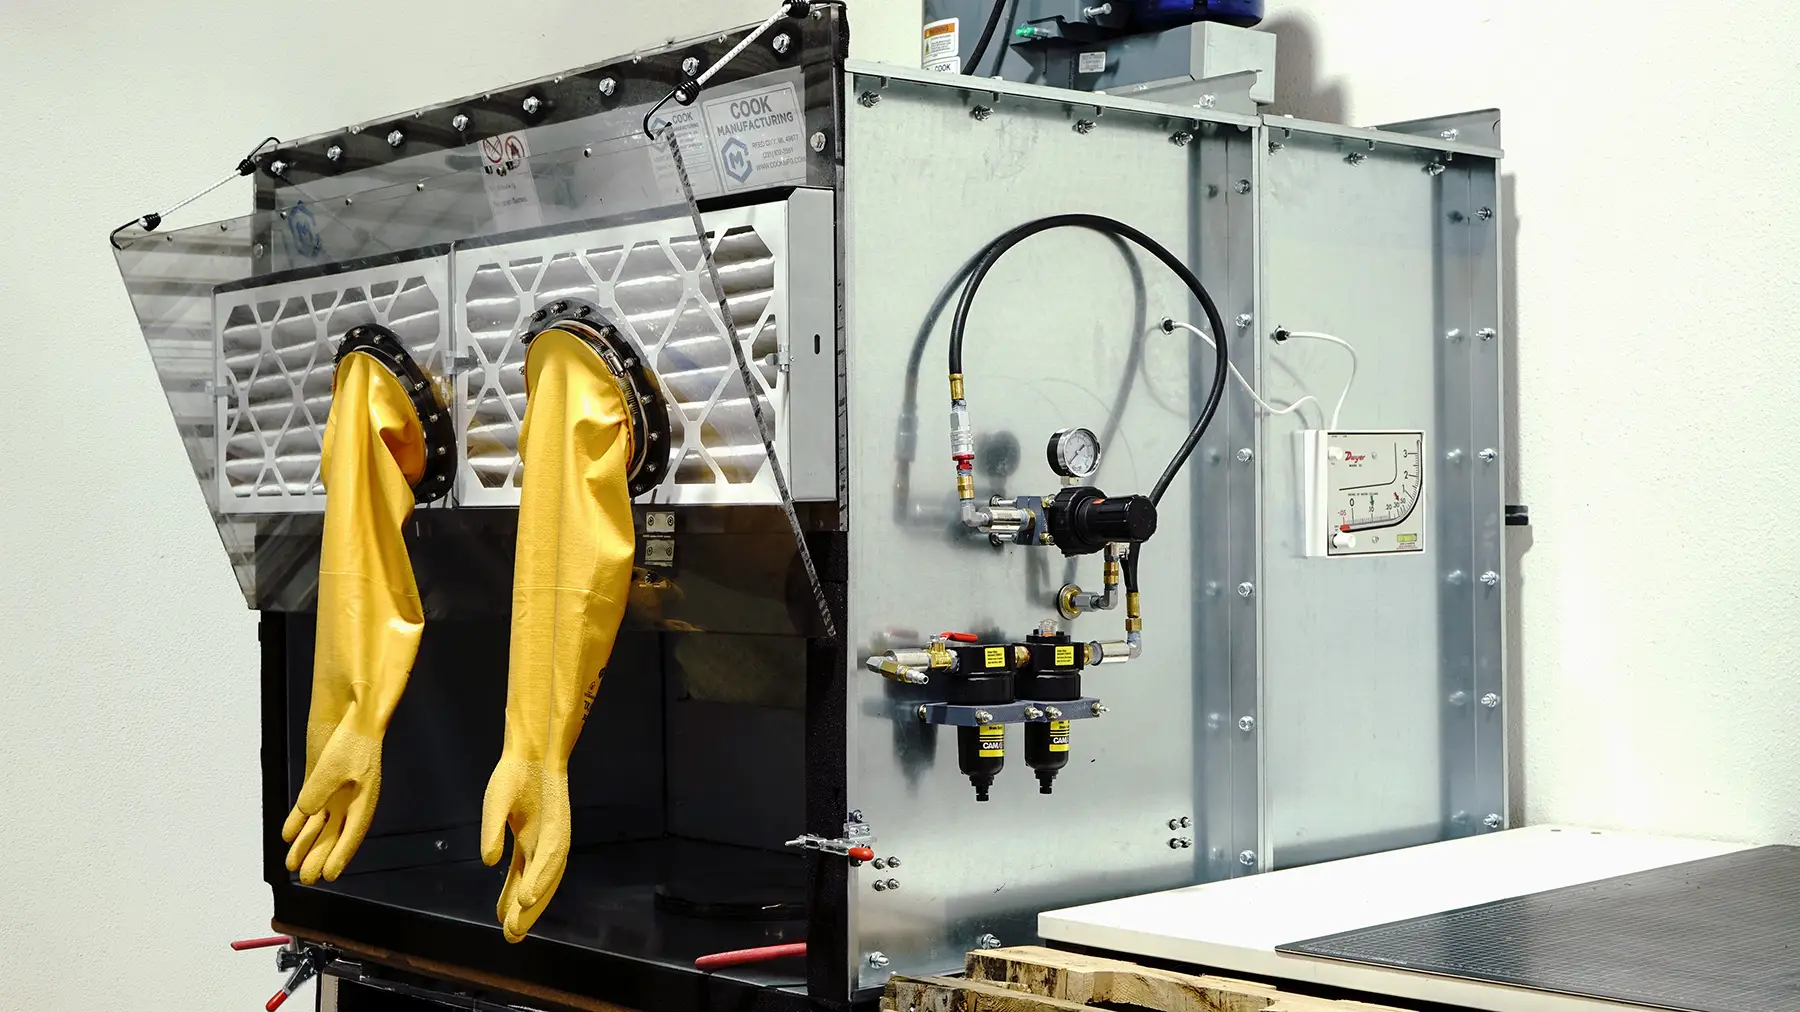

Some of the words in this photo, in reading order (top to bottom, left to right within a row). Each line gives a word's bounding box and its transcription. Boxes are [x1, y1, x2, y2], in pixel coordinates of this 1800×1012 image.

[935, 64, 951, 72] COOK
[731, 96, 772, 119] COOK
[671, 112, 694, 124] COOK
[717, 112, 794, 136] MANUFACTURING
[1345, 451, 1365, 463] Dwyer
[1403, 449, 1408, 458] 3
[1404, 470, 1409, 480] 2
[1349, 498, 1355, 507] 0
